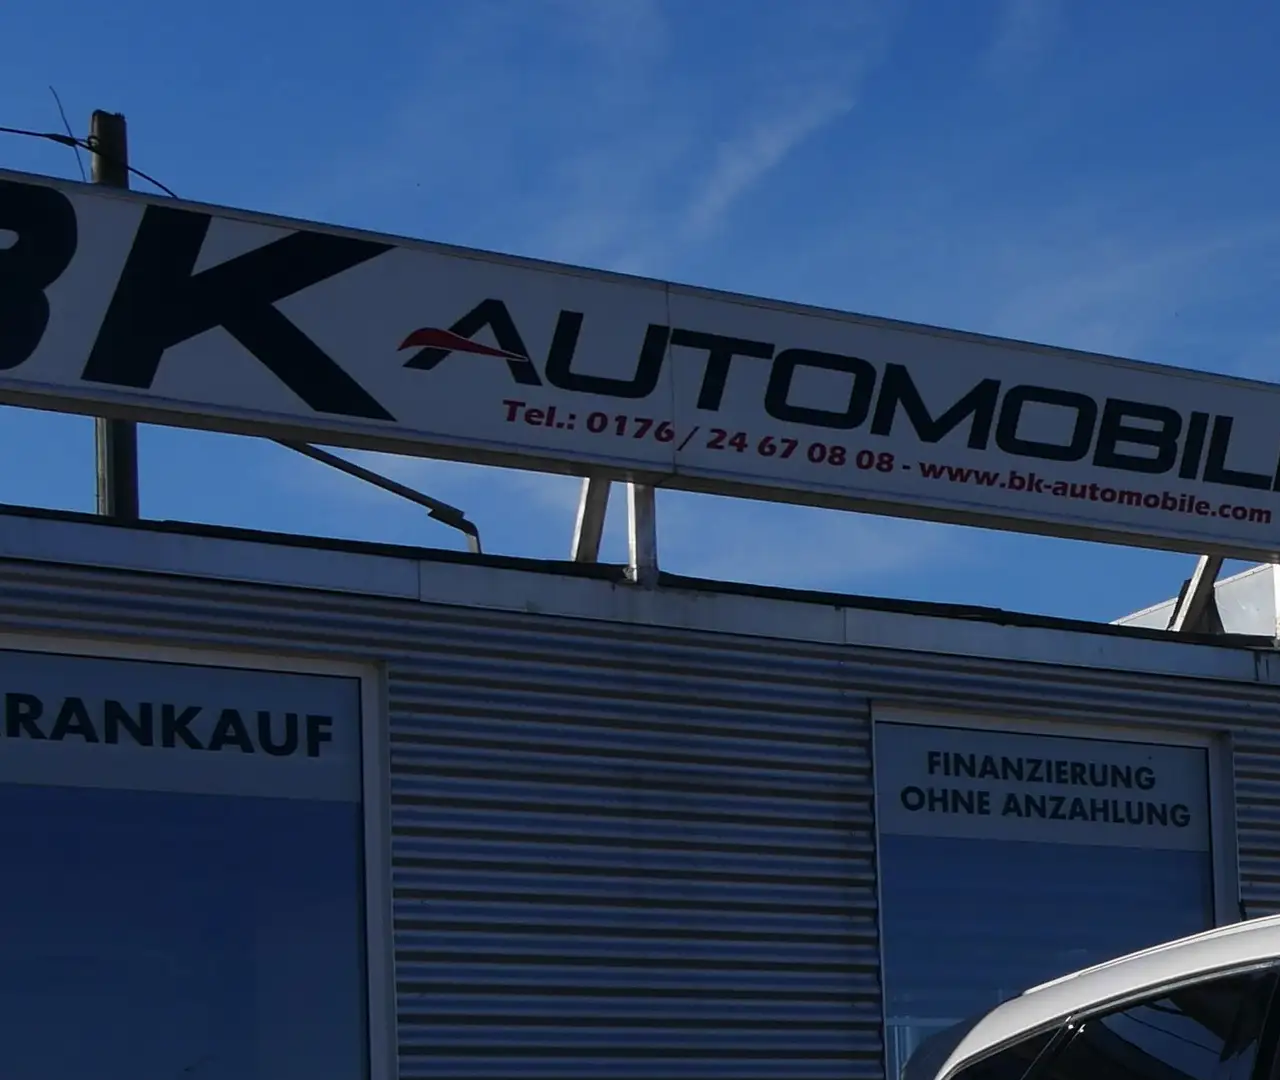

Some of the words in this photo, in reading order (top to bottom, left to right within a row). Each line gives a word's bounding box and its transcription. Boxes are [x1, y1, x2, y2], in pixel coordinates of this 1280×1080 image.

[0, 178, 399, 422] K
[502, 399, 576, 430] Tel.:
[586, 411, 675, 443] 0176
[706, 427, 748, 453] 24
[758, 435, 799, 459] 67
[807, 442, 846, 467] 08
[856, 449, 895, 474] 08
[918, 459, 1273, 525] www.bk-automobile.com
[5, 692, 334, 758] RANKAUF
[927, 750, 1156, 791] FINANZIERUNG
[900, 785, 991, 816] OHNE
[1001, 792, 1191, 828] ANZAHLUNG
